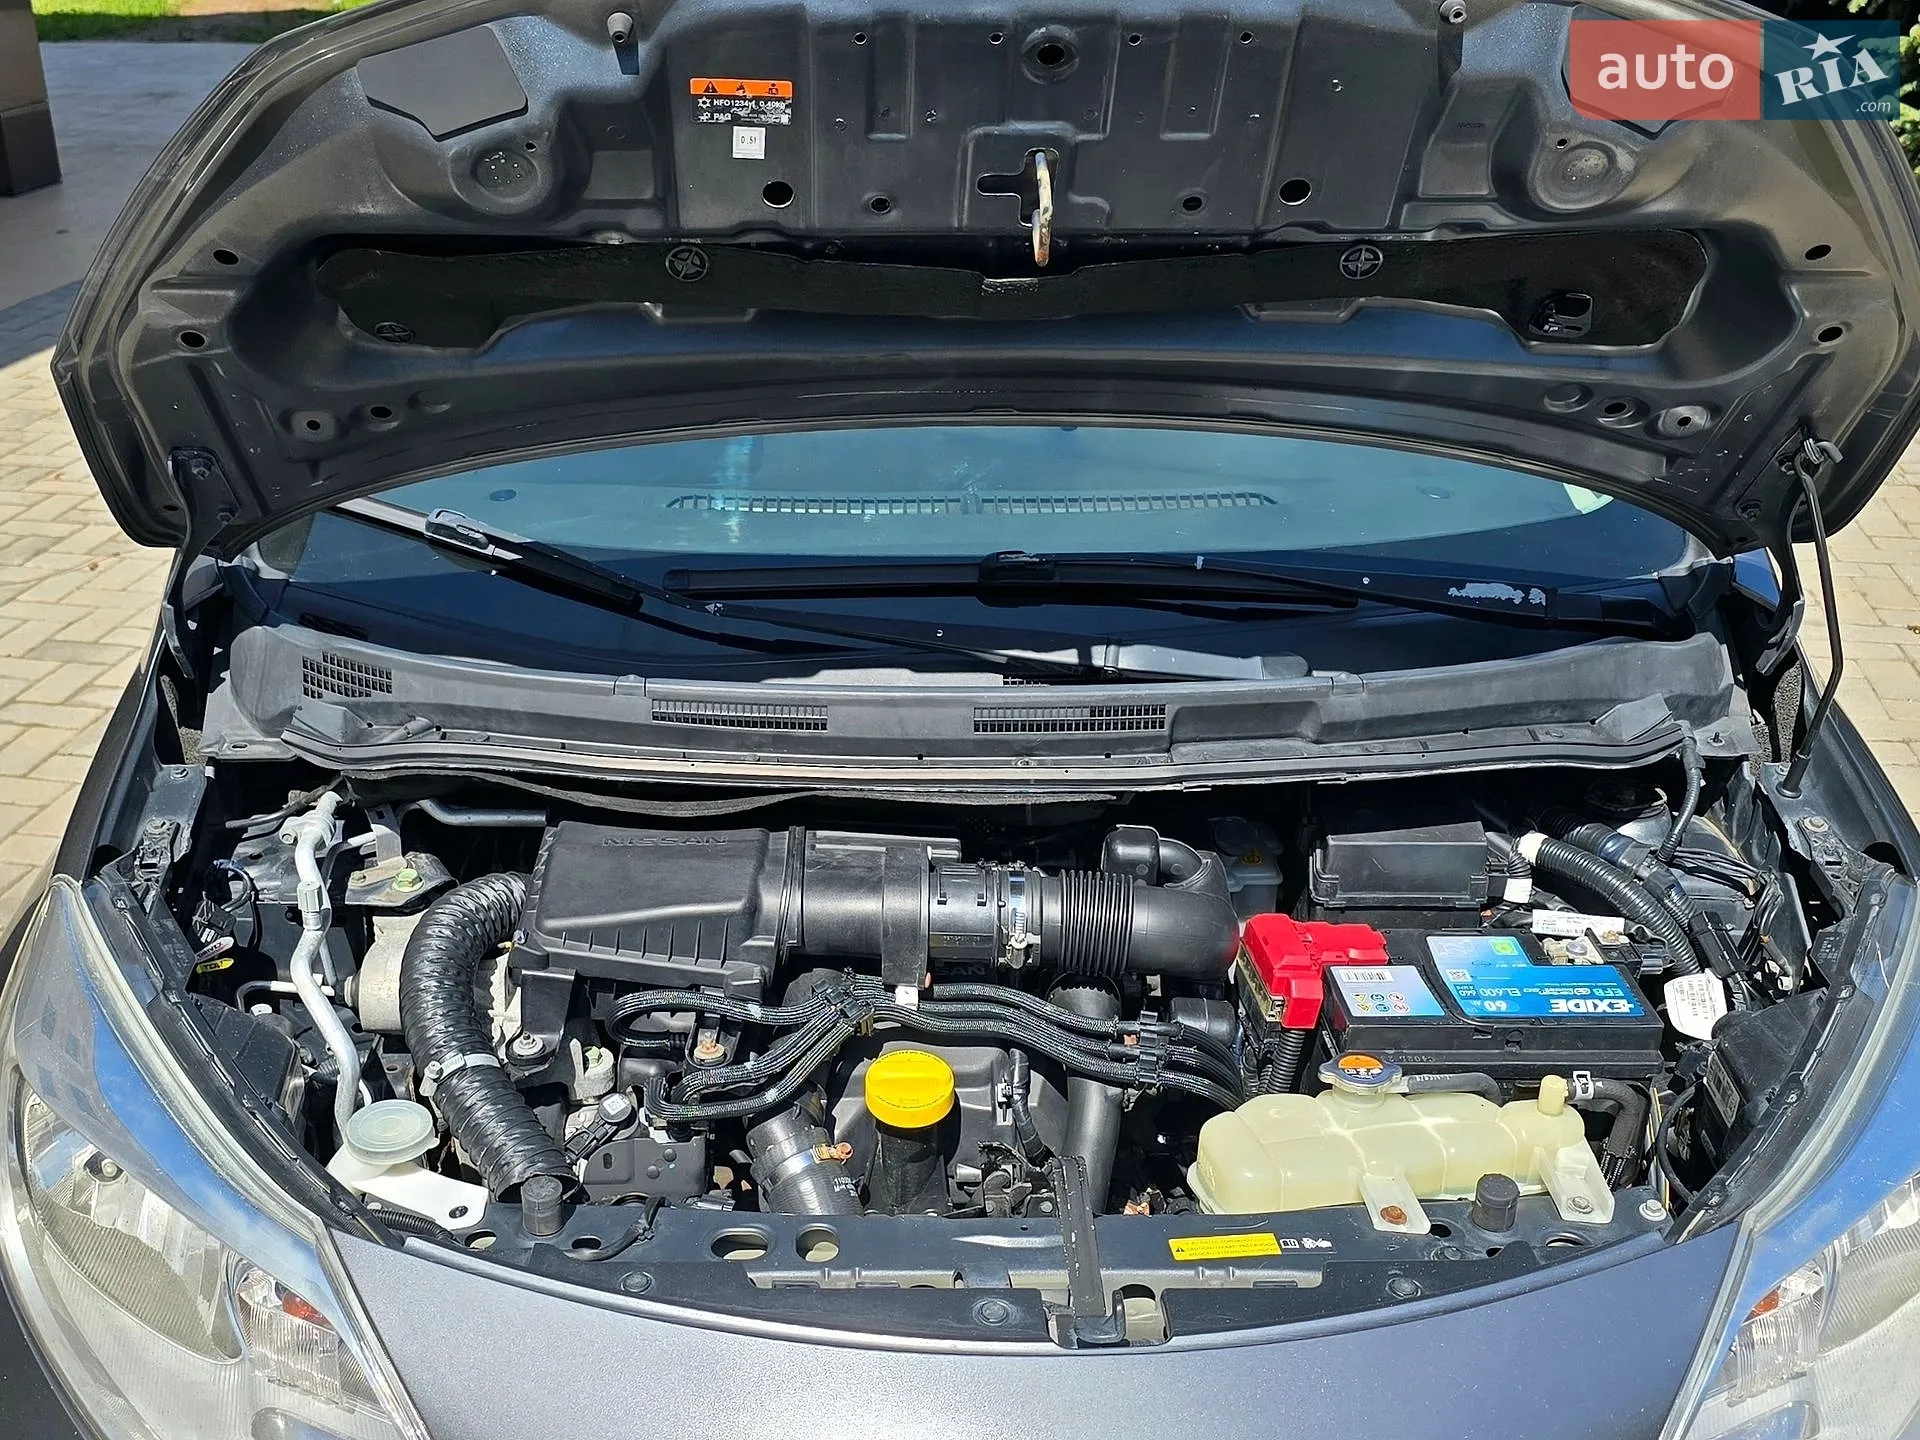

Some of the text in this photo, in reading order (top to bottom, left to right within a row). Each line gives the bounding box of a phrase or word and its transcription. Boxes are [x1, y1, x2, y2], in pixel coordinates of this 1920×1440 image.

[601, 835, 728, 848] NISSAN
[934, 964, 986, 976] SAN
[1479, 987, 1522, 997] EL600
[1483, 999, 1508, 1012] 60
[1549, 999, 1634, 1013] EXIDE
